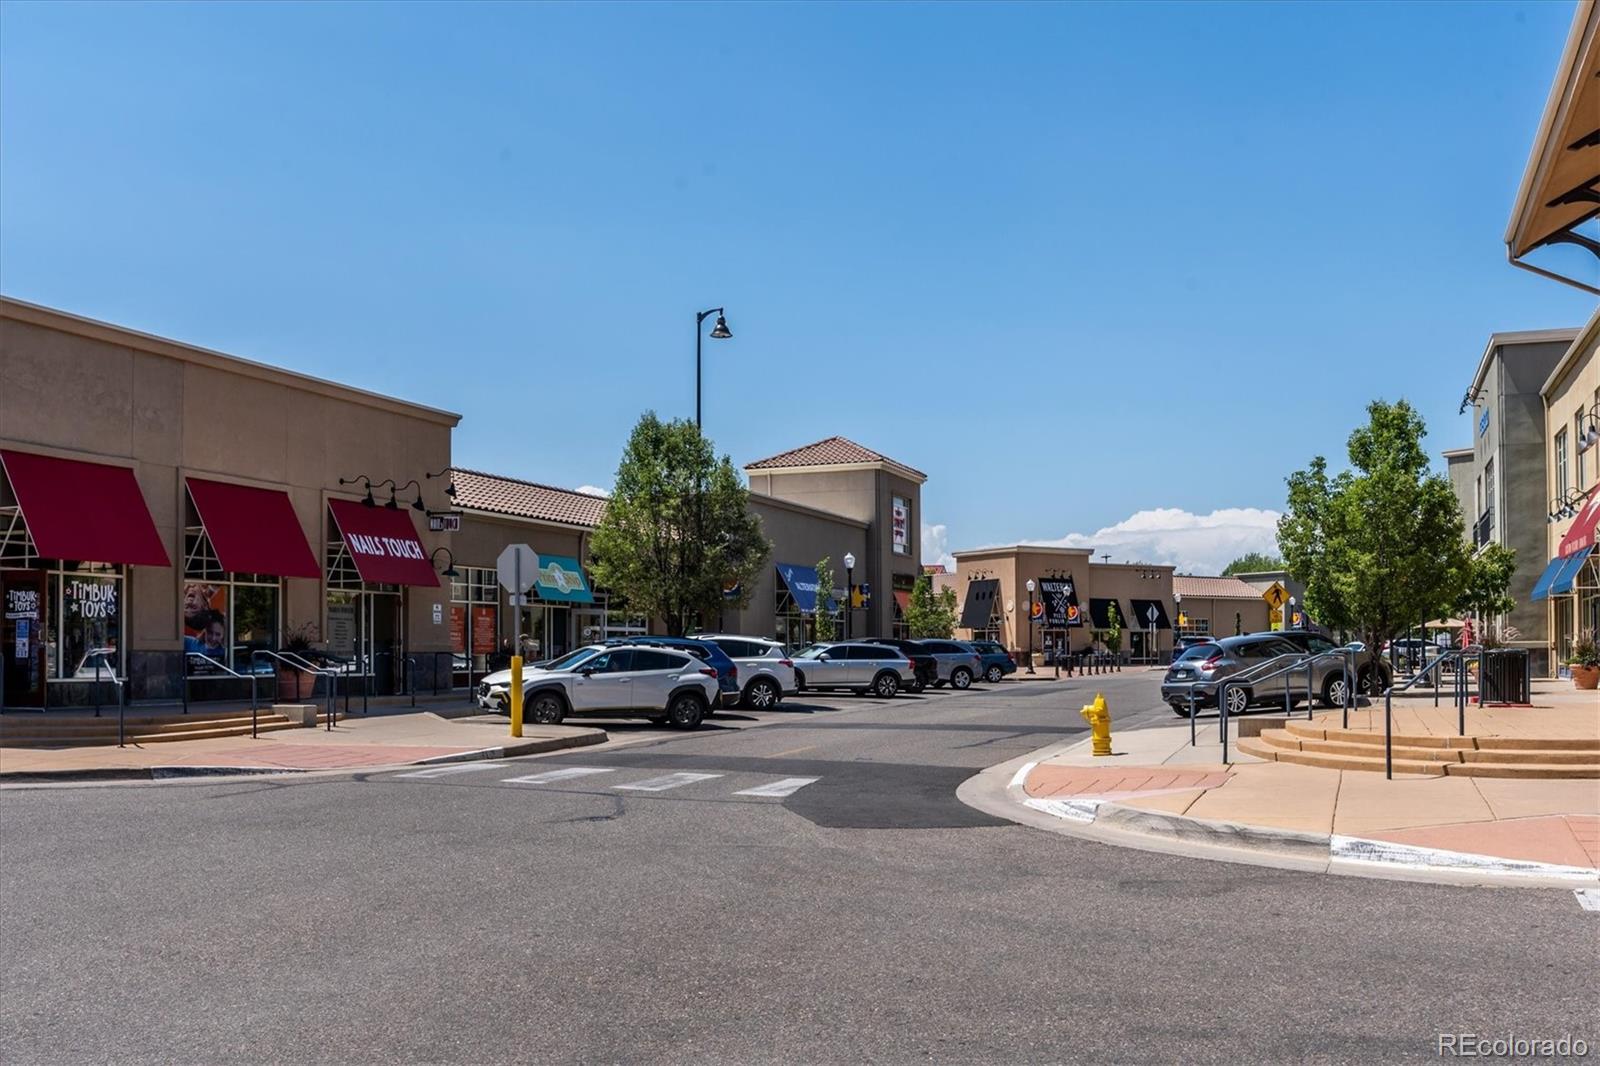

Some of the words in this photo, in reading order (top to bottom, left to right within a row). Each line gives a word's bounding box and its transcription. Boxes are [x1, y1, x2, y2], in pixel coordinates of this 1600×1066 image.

[348, 533, 385, 556] NAILS
[383, 537, 425, 560] TOUCH
[14, 601, 31, 612] TOYS
[79, 600, 106, 618] TOYS
